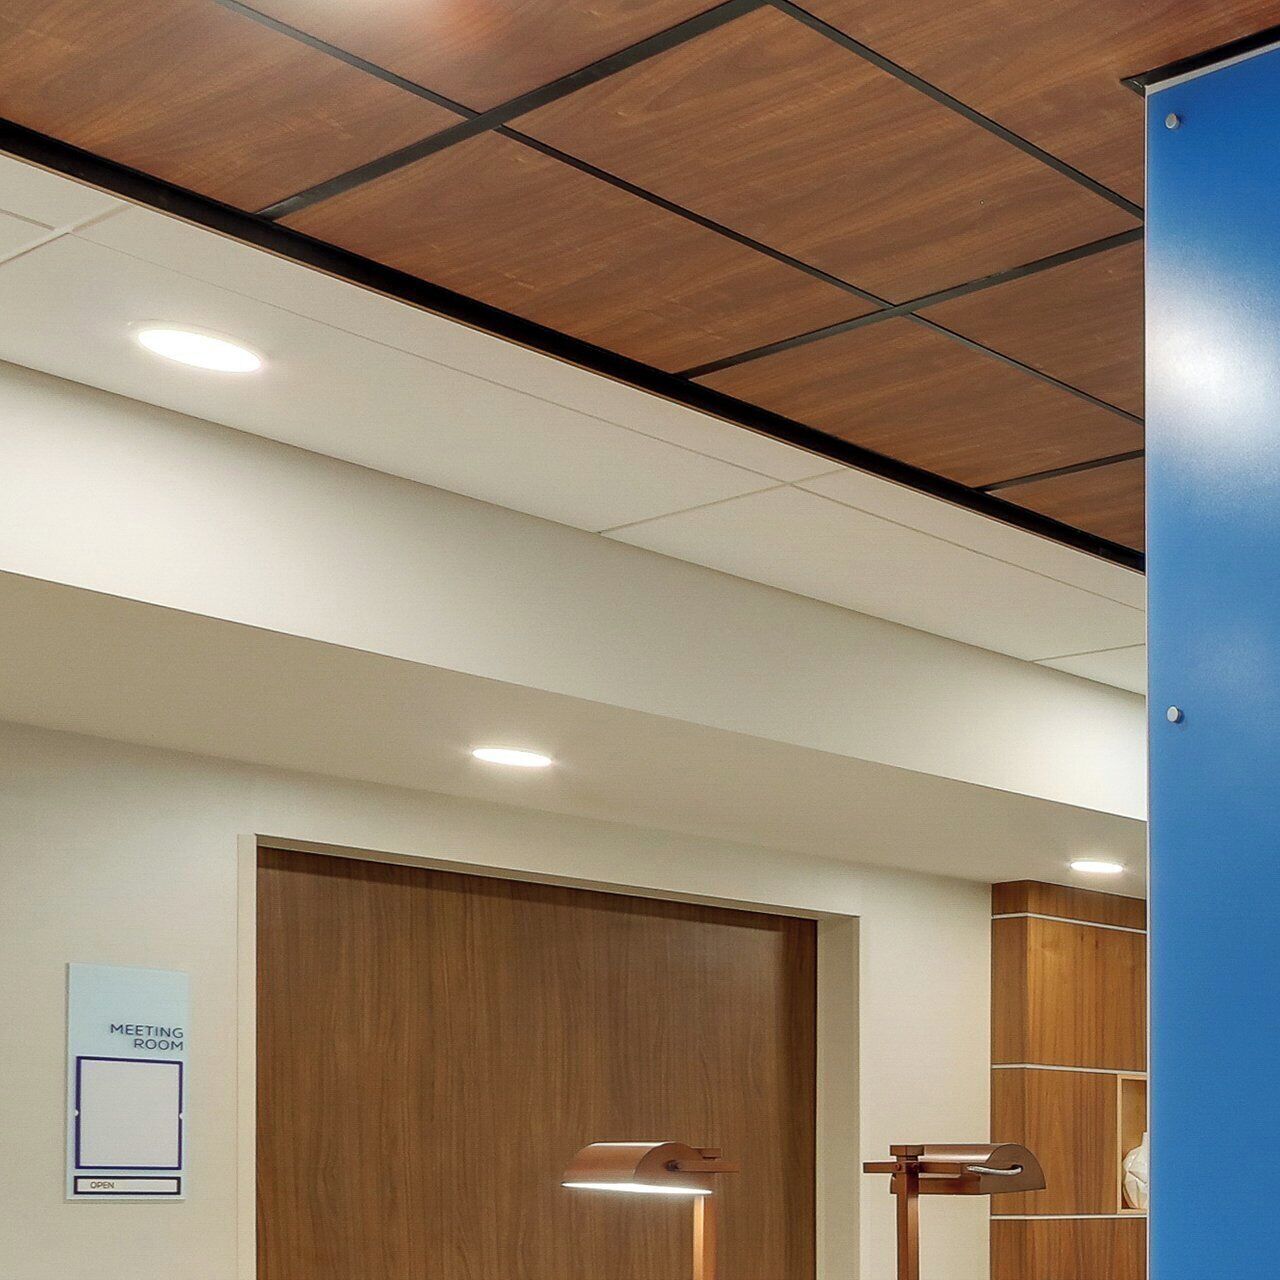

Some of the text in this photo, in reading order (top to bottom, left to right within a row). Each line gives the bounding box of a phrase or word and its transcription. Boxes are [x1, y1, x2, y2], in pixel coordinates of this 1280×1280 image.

[110, 1023, 184, 1039] MEETING
[133, 1038, 184, 1051] ROOM
[90, 1181, 115, 1189] OPEN
